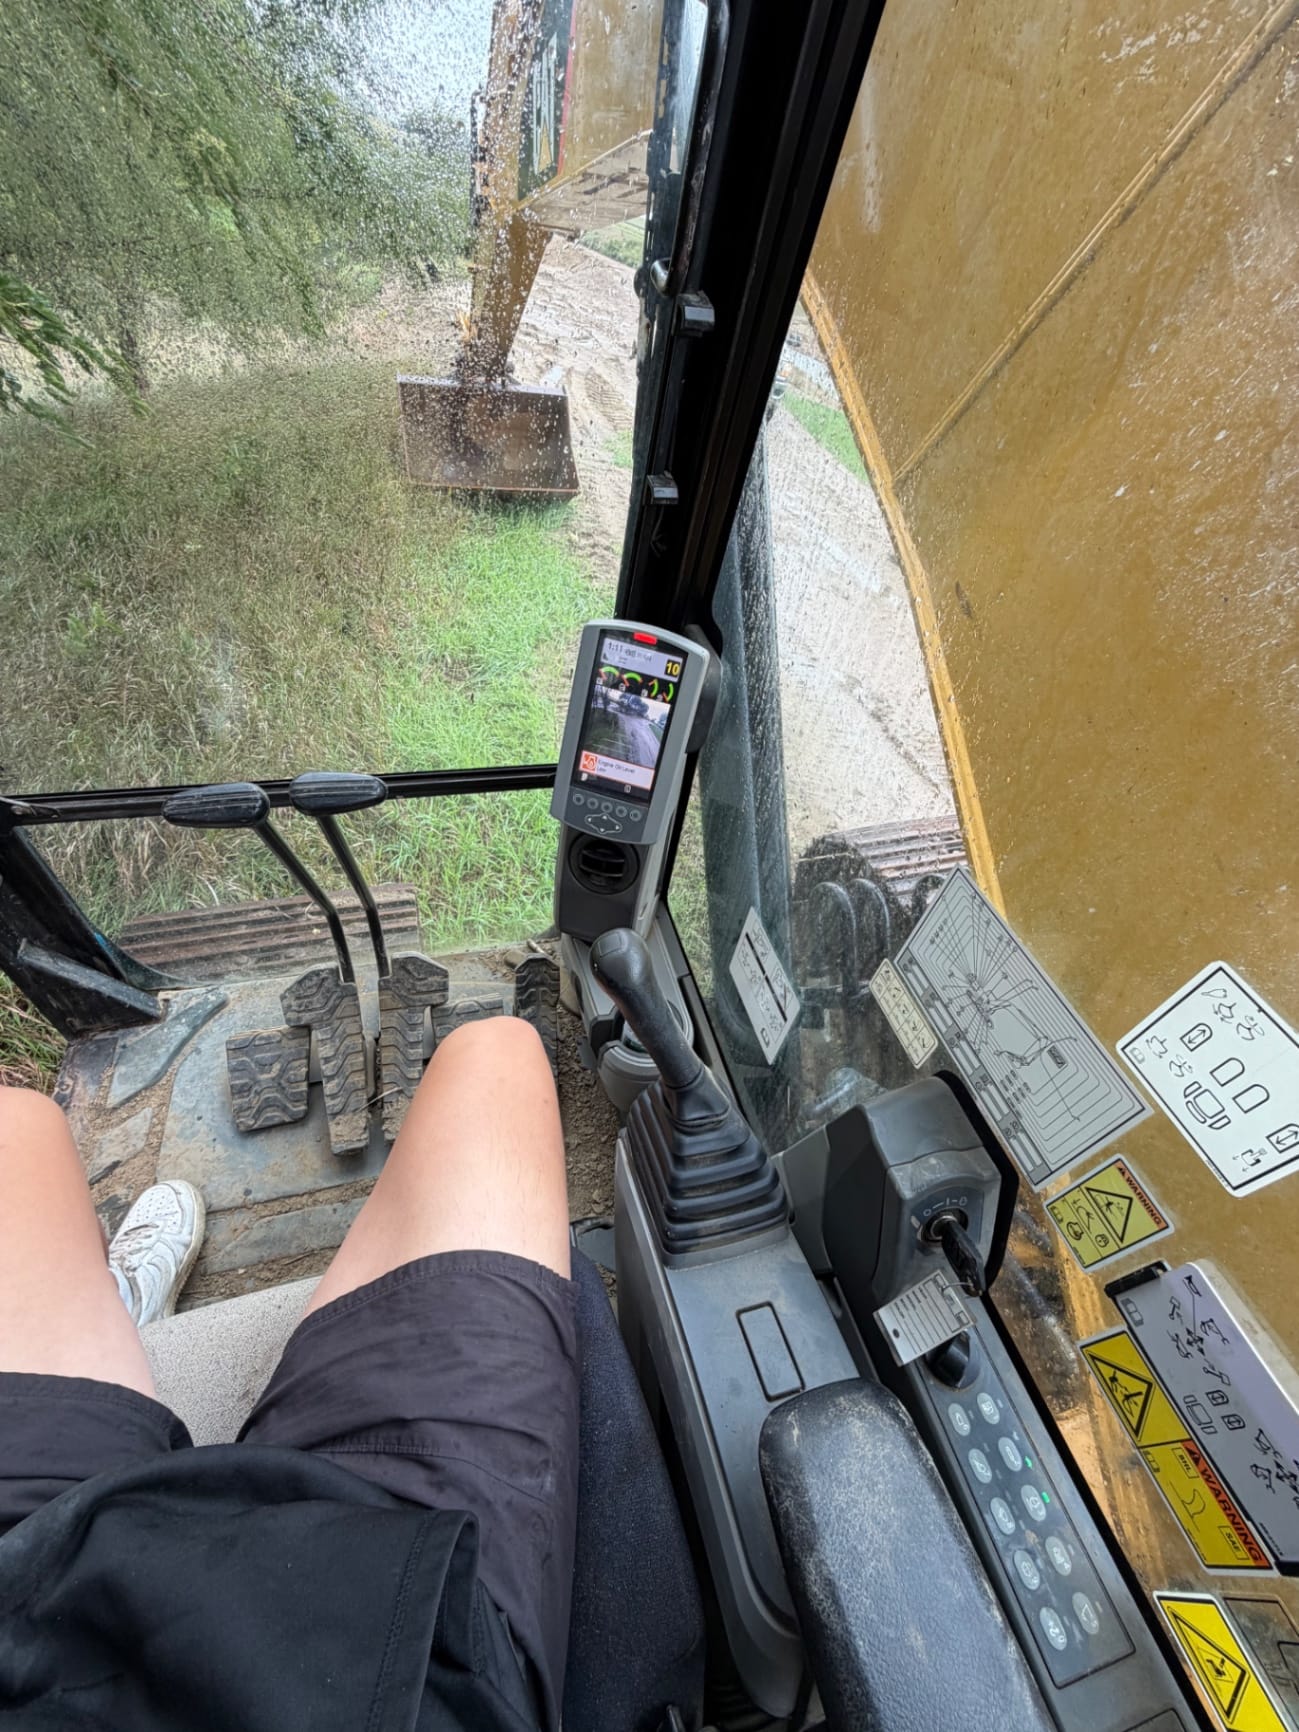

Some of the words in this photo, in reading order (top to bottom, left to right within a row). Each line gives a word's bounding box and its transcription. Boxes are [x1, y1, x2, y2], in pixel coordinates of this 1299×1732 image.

[667, 662, 680, 676] 10
[1126, 1177, 1162, 1225] WARNING
[1202, 1468, 1262, 1561] WARNING
[1226, 1531, 1241, 1553] SAE
